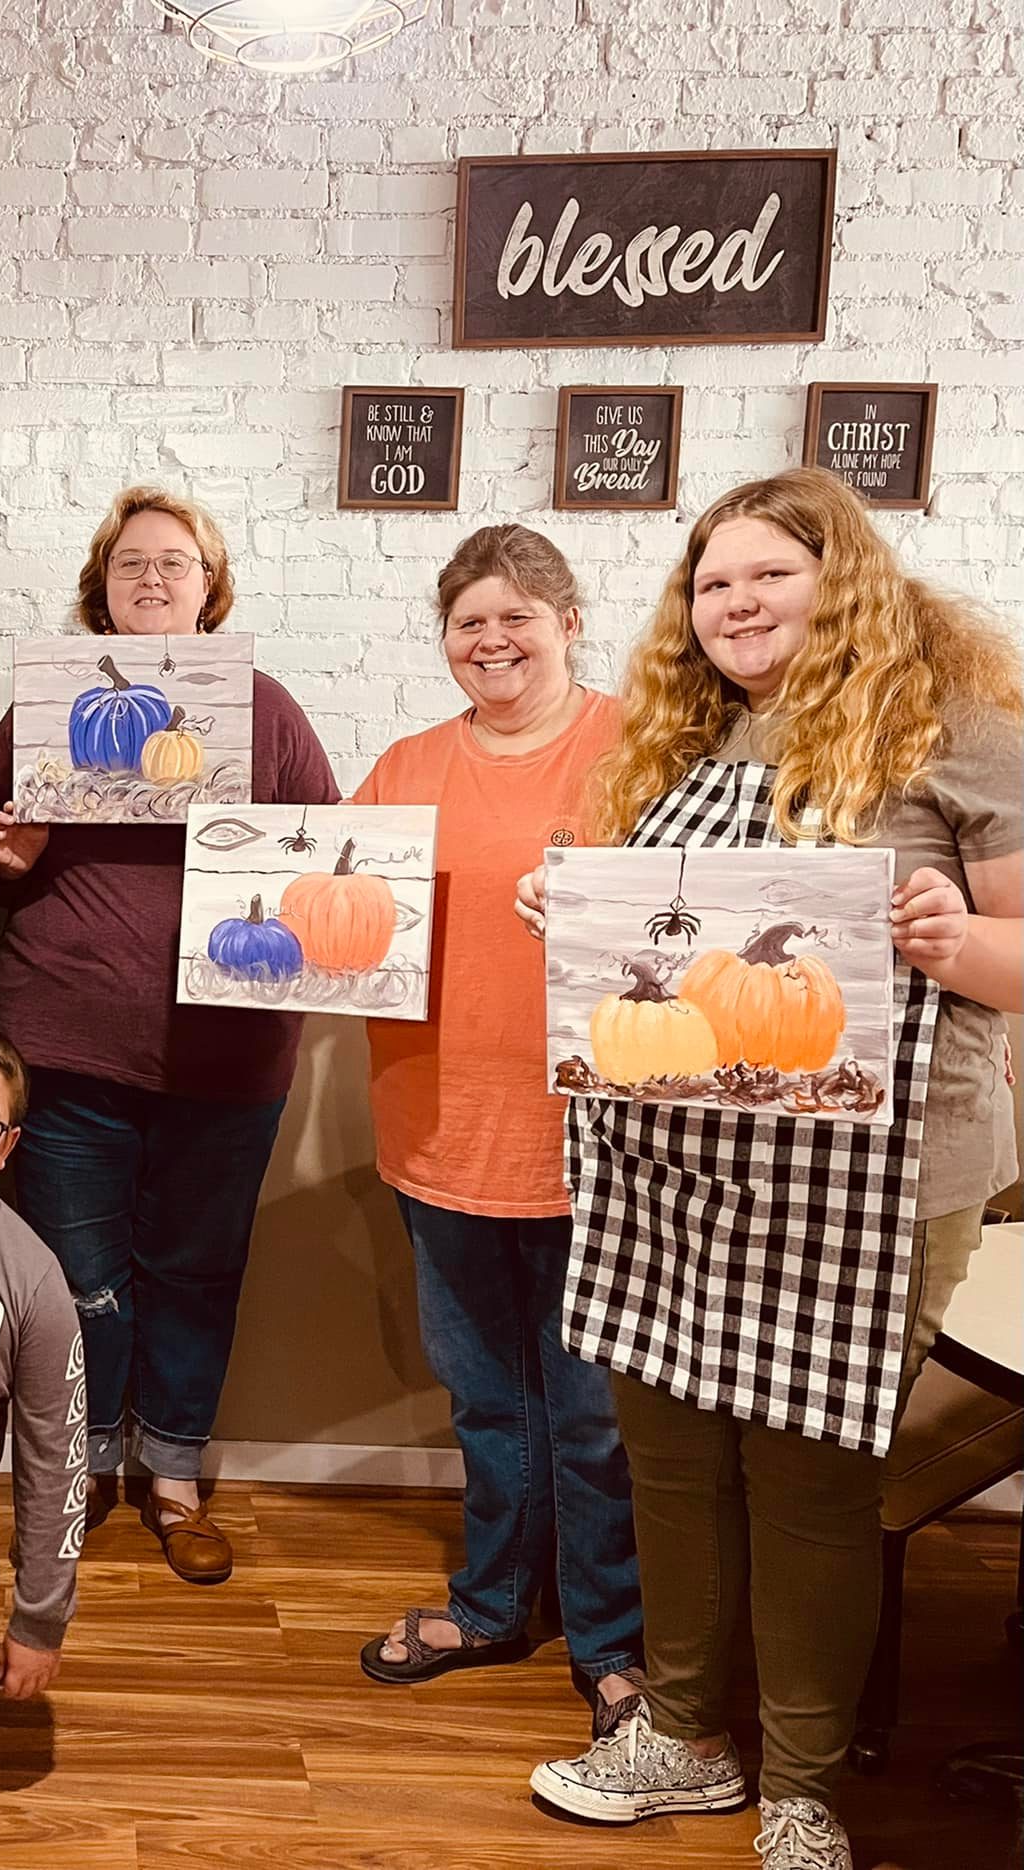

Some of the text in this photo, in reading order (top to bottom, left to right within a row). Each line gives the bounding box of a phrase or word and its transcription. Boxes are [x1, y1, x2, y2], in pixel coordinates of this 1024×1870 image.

[496, 191, 784, 307] blessed
[367, 404, 434, 423] BE STILL &
[596, 406, 643, 425] GIVE US
[864, 403, 877, 420] IN
[366, 425, 433, 443] KNOW THAT
[827, 422, 910, 452] CHRIST
[385, 444, 412, 461] I AM
[583, 428, 661, 464] THIS Day
[602, 457, 642, 472] OUR DAILY
[831, 453, 901, 469] ALONE MY HOPE
[370, 464, 425, 494] GOD
[573, 462, 650, 492] Bread
[856, 471, 887, 488] FOUND
